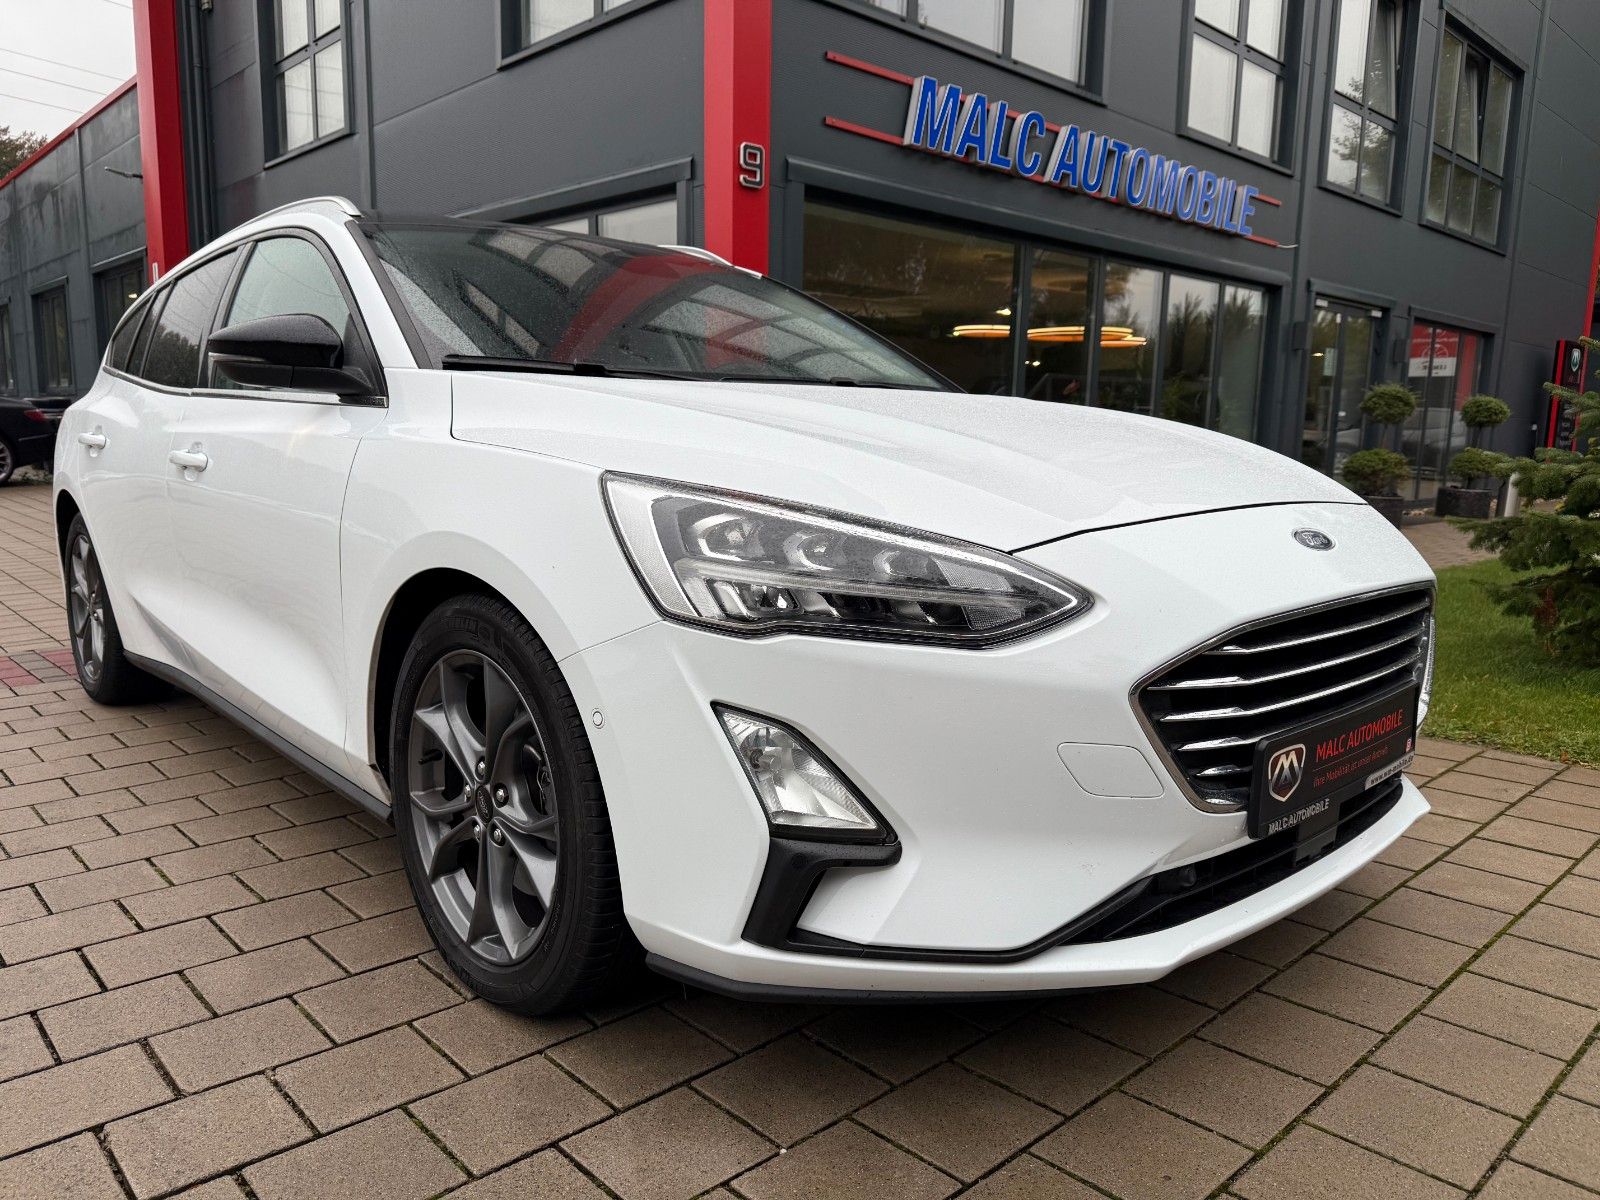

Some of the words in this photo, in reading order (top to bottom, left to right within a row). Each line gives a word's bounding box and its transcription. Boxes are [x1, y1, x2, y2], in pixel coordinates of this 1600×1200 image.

[740, 141, 765, 189] 9
[906, 75, 1046, 177] MALC
[1045, 124, 1259, 236] AUTOMOBILE
[1315, 734, 1346, 763] MALC
[1346, 708, 1404, 750] AUTOMOBILE
[1268, 816, 1288, 836] MALC
[1288, 798, 1330, 828] AUTOMOBILE
